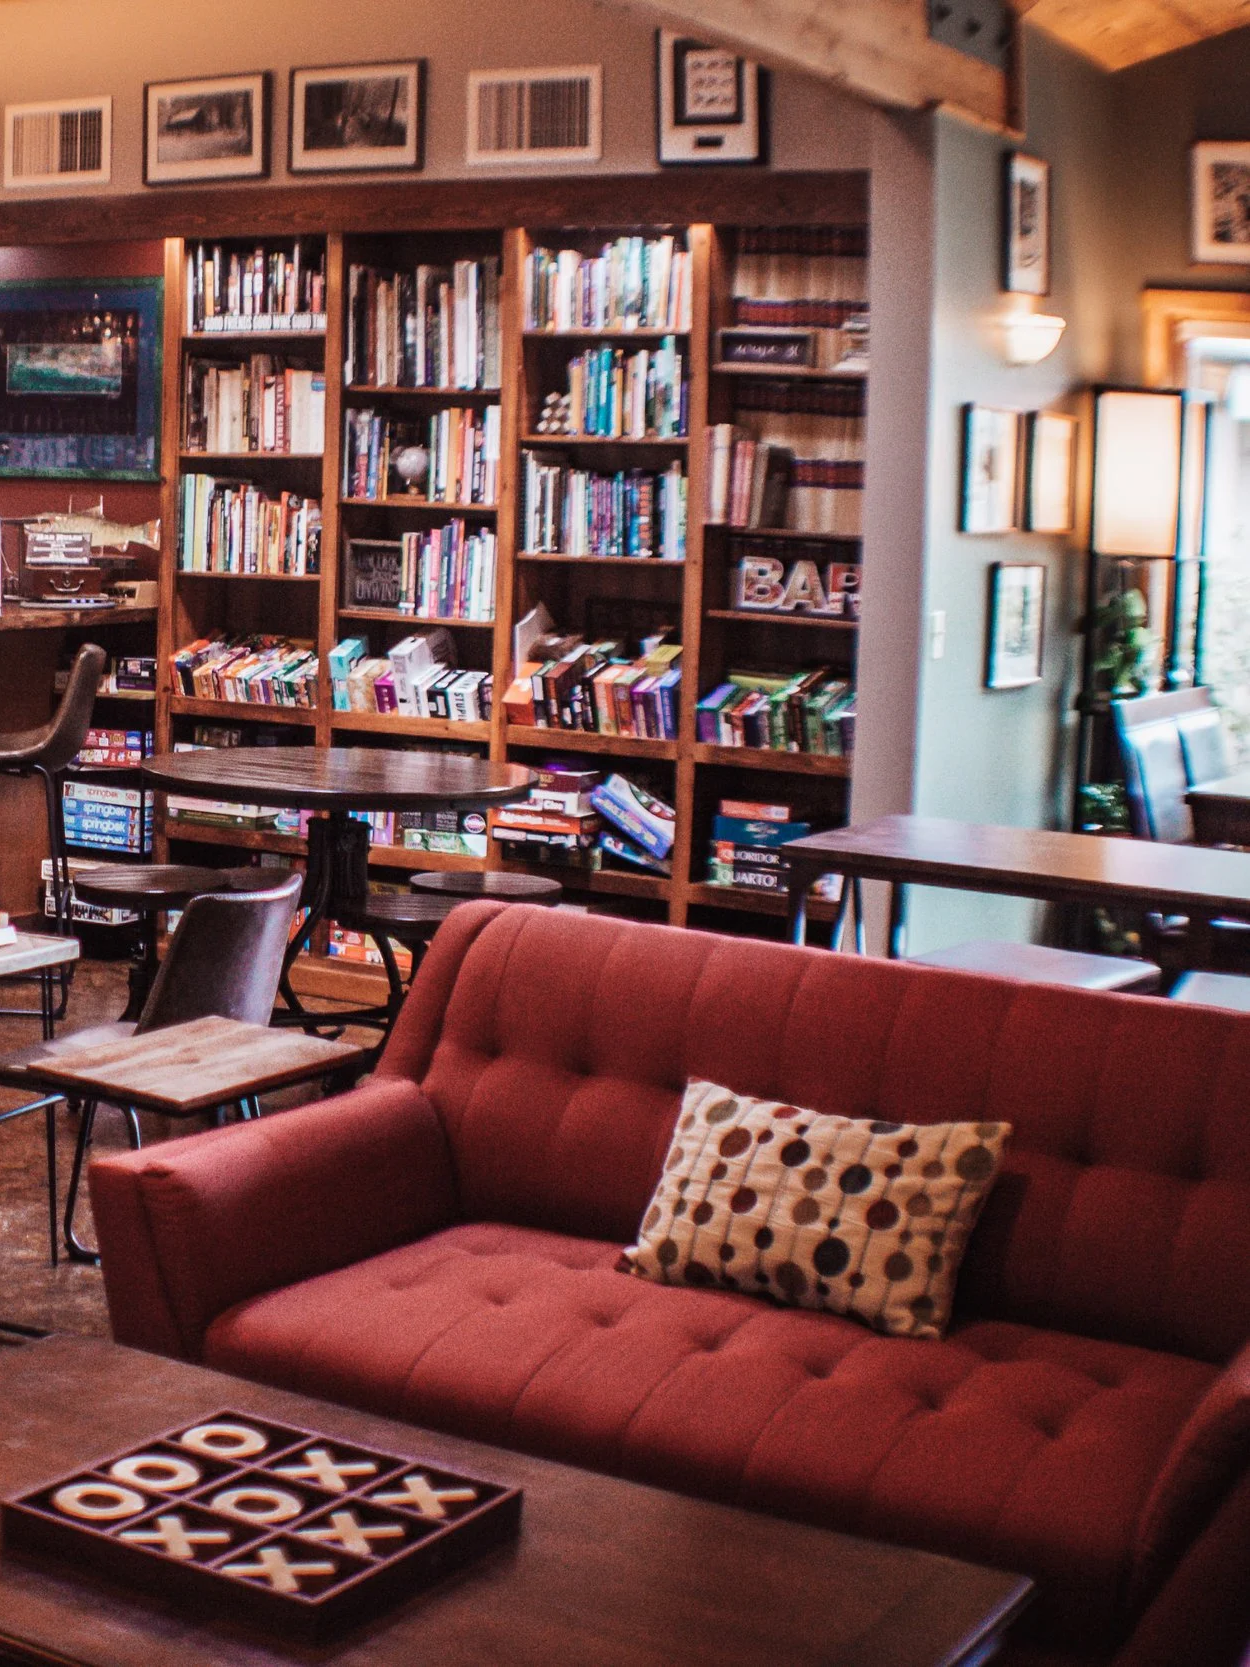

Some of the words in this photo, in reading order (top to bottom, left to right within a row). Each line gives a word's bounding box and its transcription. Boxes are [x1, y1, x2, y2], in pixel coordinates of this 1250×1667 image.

[740, 556, 862, 615] BAR
[82, 802, 127, 818] springbok
[81, 818, 126, 833] springbok
[719, 869, 778, 888] QUARTO!
